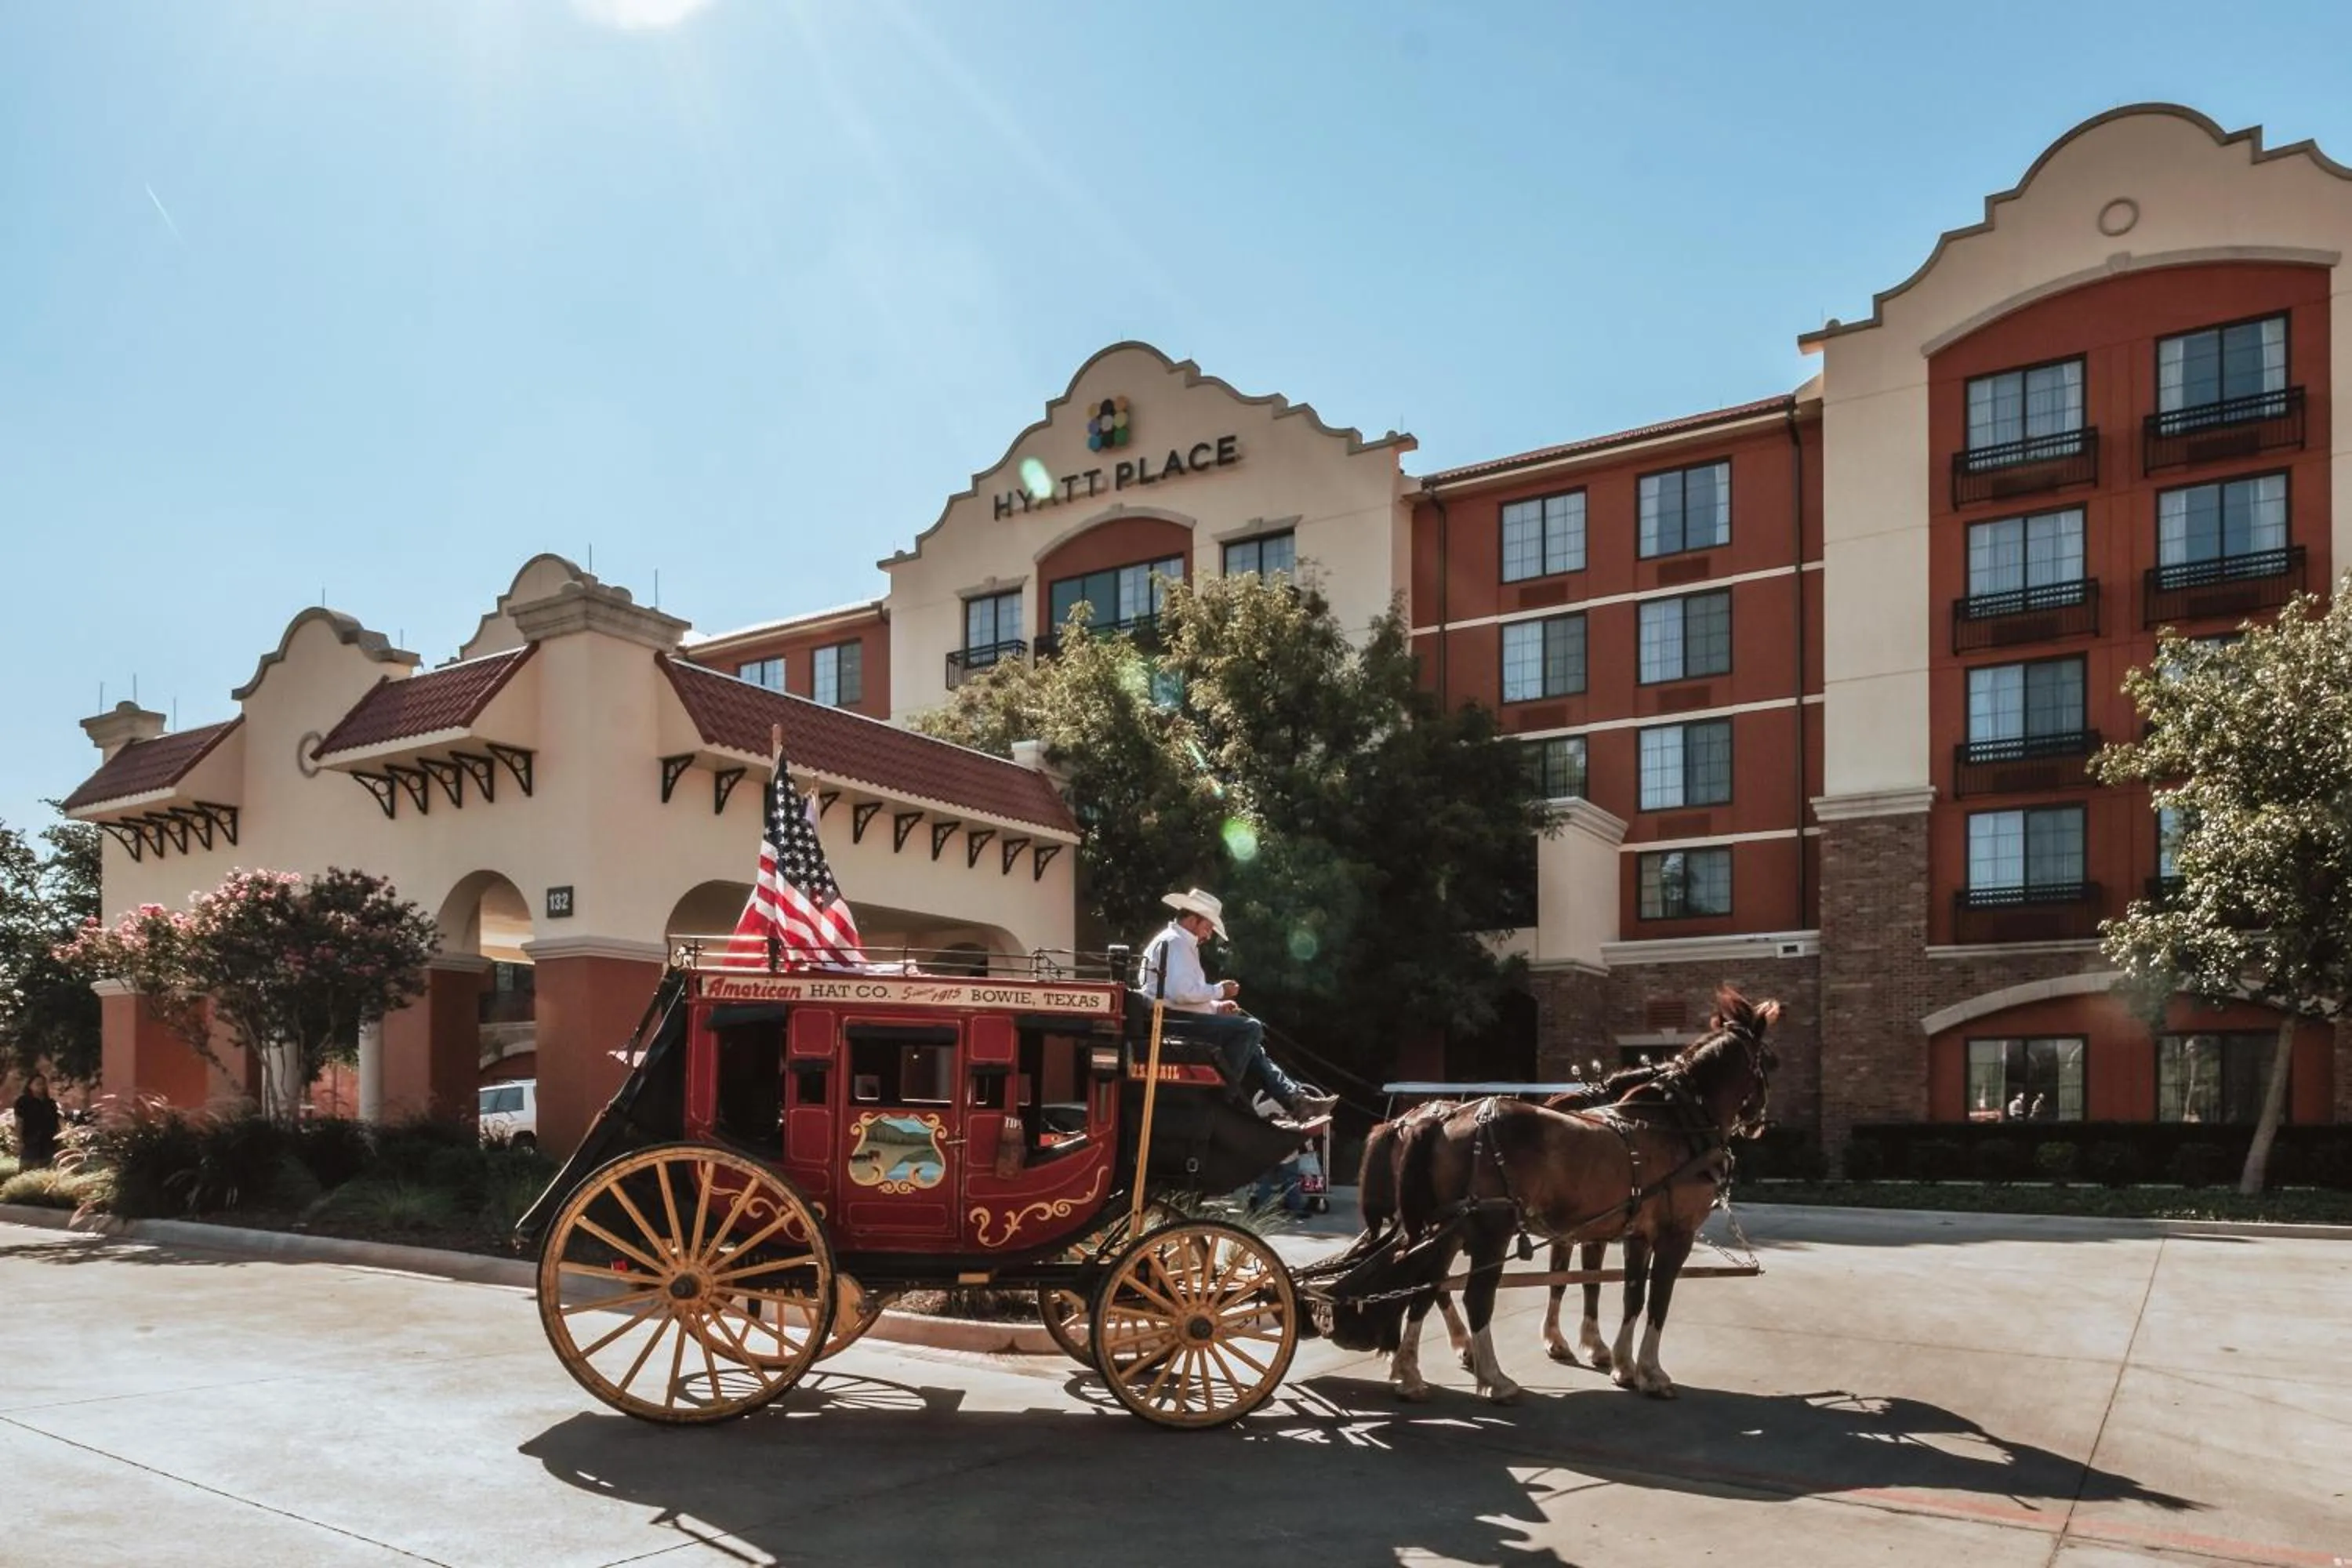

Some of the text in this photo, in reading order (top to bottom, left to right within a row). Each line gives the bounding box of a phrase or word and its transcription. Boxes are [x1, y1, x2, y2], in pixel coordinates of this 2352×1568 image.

[1115, 434, 1238, 491] PLACE
[550, 892, 568, 910] 132
[707, 977, 802, 1000] American
[810, 983, 850, 998] HAT
[855, 983, 891, 999] CO.
[971, 988, 1036, 1007] BOWIE,
[1044, 992, 1100, 1008] TEXAS
[1150, 1065, 1180, 1080] AIL
